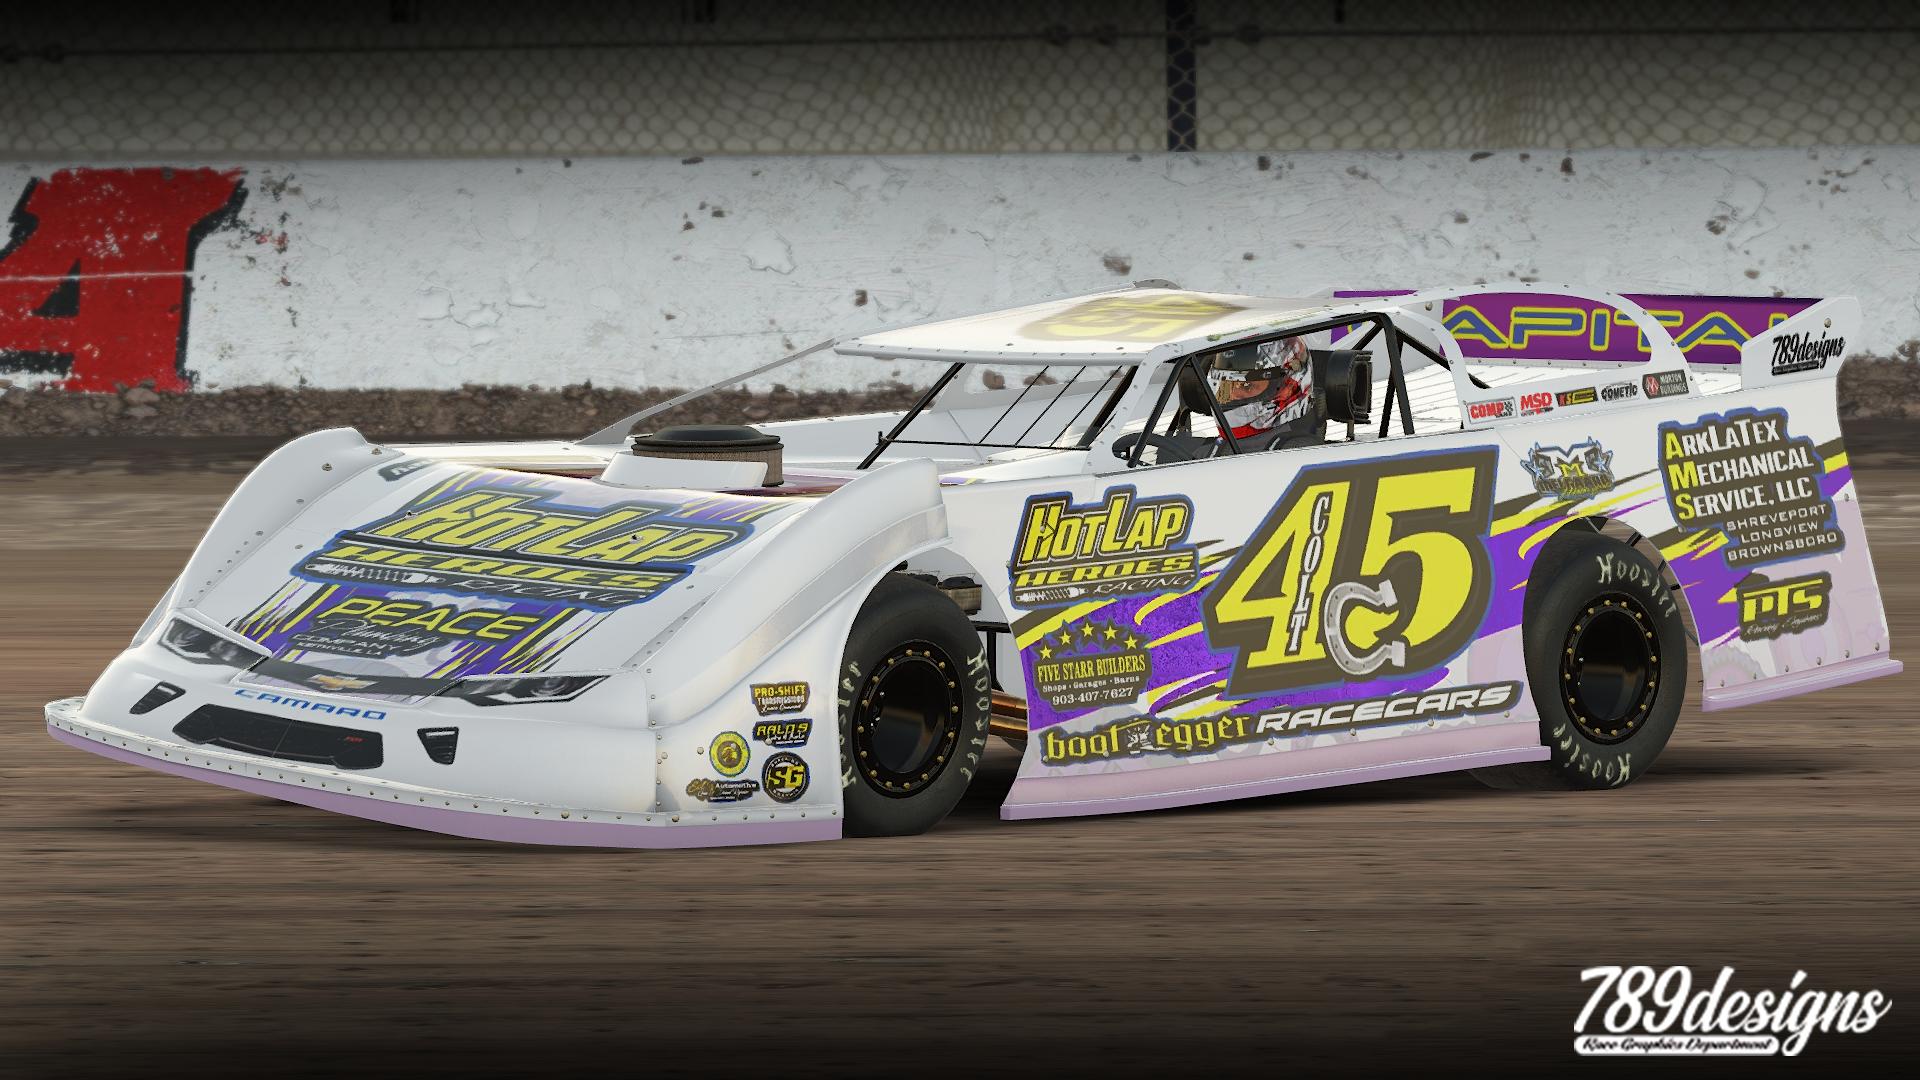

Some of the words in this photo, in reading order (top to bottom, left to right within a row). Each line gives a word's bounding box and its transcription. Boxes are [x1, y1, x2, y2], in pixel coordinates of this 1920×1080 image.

[1772, 330, 1846, 370] 789designs
[1520, 392, 1553, 411] MSD
[1668, 446, 1815, 491] MECHANICAL
[1776, 476, 1813, 503] LLC
[1021, 498, 1187, 562] HOTLAP
[1726, 504, 1827, 531] SHREVEPORT
[1741, 522, 1818, 544] LONGVIEW
[1728, 532, 1838, 561] BROWNSBORO
[324, 545, 672, 589] HEROES
[1016, 556, 1194, 588] HEROES
[1215, 467, 1476, 669] 45
[1288, 495, 1331, 652] COLT
[1093, 575, 1195, 594] RACING
[317, 598, 539, 638] PEACE
[1037, 664, 1060, 682] FIVE
[1063, 660, 1094, 680] STARR
[1096, 655, 1146, 676] BUILDERS
[1043, 684, 1067, 693] Shops
[1073, 679, 1107, 689] Garages
[1114, 676, 1140, 684] Barns
[234, 688, 387, 720] CAMARO
[1256, 685, 1513, 733] RACECARS
